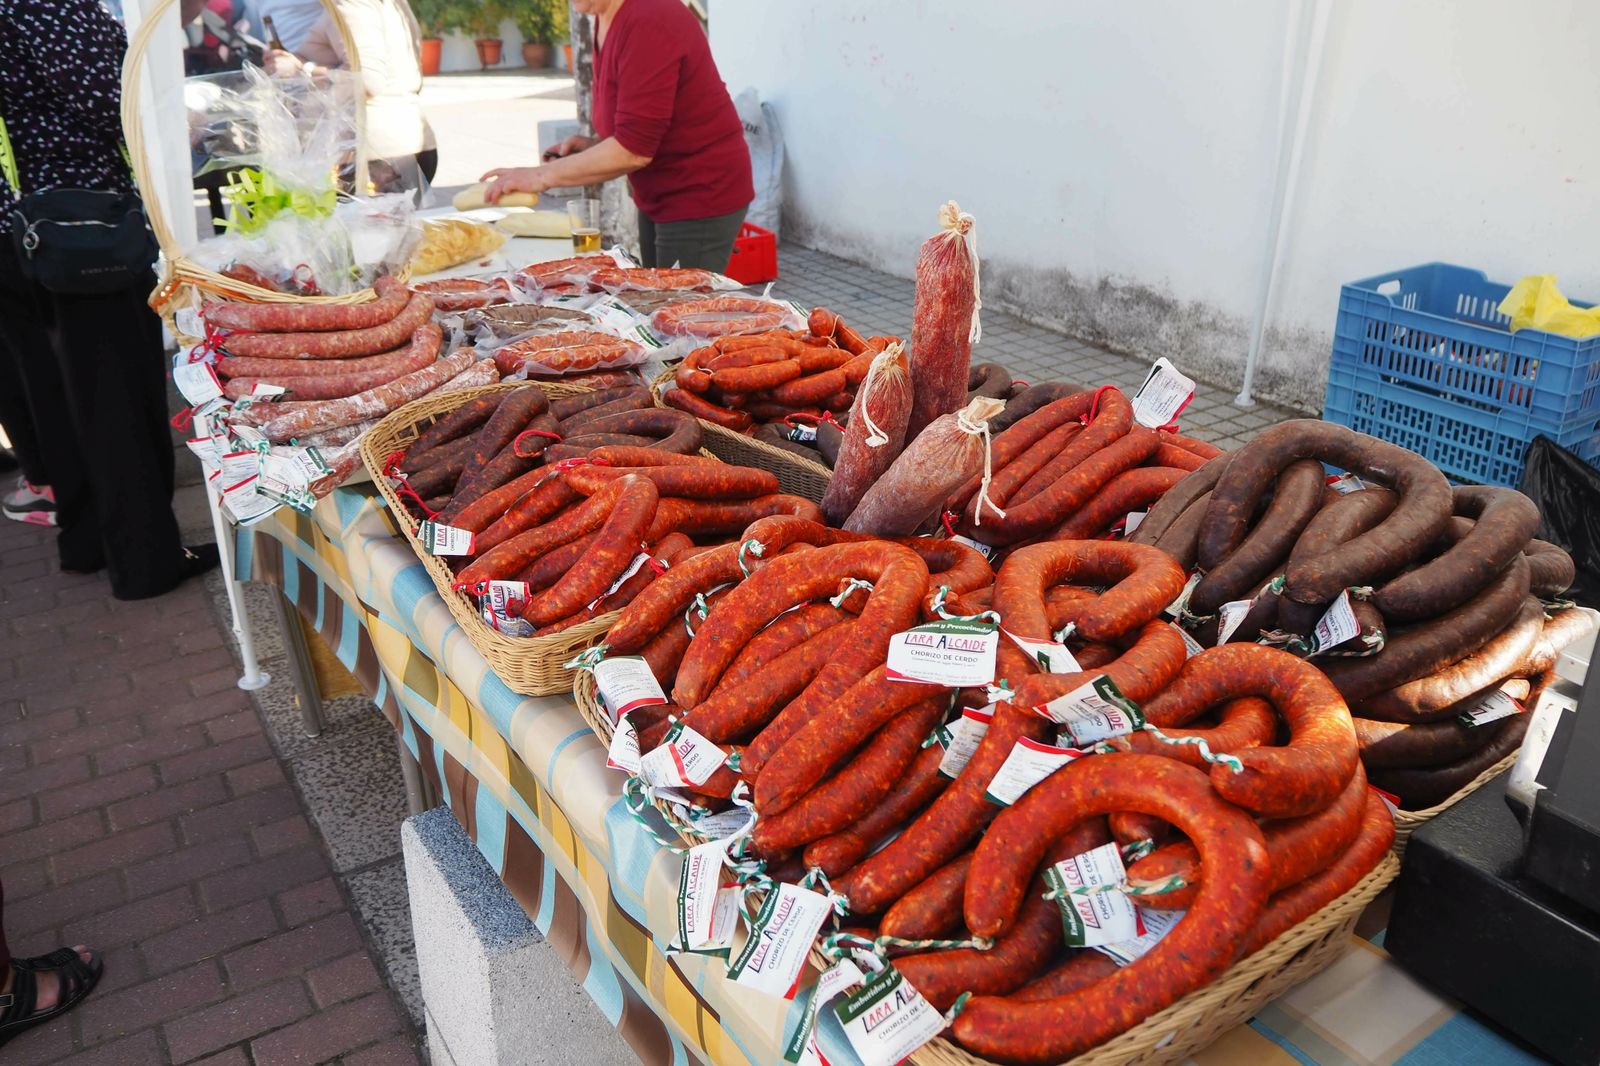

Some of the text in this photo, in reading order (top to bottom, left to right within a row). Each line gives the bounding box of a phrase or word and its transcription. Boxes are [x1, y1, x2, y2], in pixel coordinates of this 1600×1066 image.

[436, 527, 448, 547] LARA
[904, 633, 988, 653] LARA ALCAIDE
[910, 649, 942, 660] CHORIZO
[943, 653, 953, 662] DE
[954, 655, 978, 663] CERDO
[686, 752, 700, 770] ERDO
[687, 854, 703, 934] LARA ALCAIDE
[1088, 874, 1098, 885] DE
[734, 937, 756, 972] Embutidos
[753, 888, 779, 930] Precocinados
[748, 942, 771, 973] LARA
[763, 894, 796, 941] ALCAIDE
[768, 936, 785, 970] CHORIZO
[782, 928, 790, 937] DE
[787, 905, 803, 927] CERDO
[848, 981, 887, 1014] Embutidos
[886, 977, 893, 987] y
[861, 1001, 895, 1034] LARA
[878, 1012, 909, 1040] CHORIZO
[909, 1006, 919, 1016] DE
